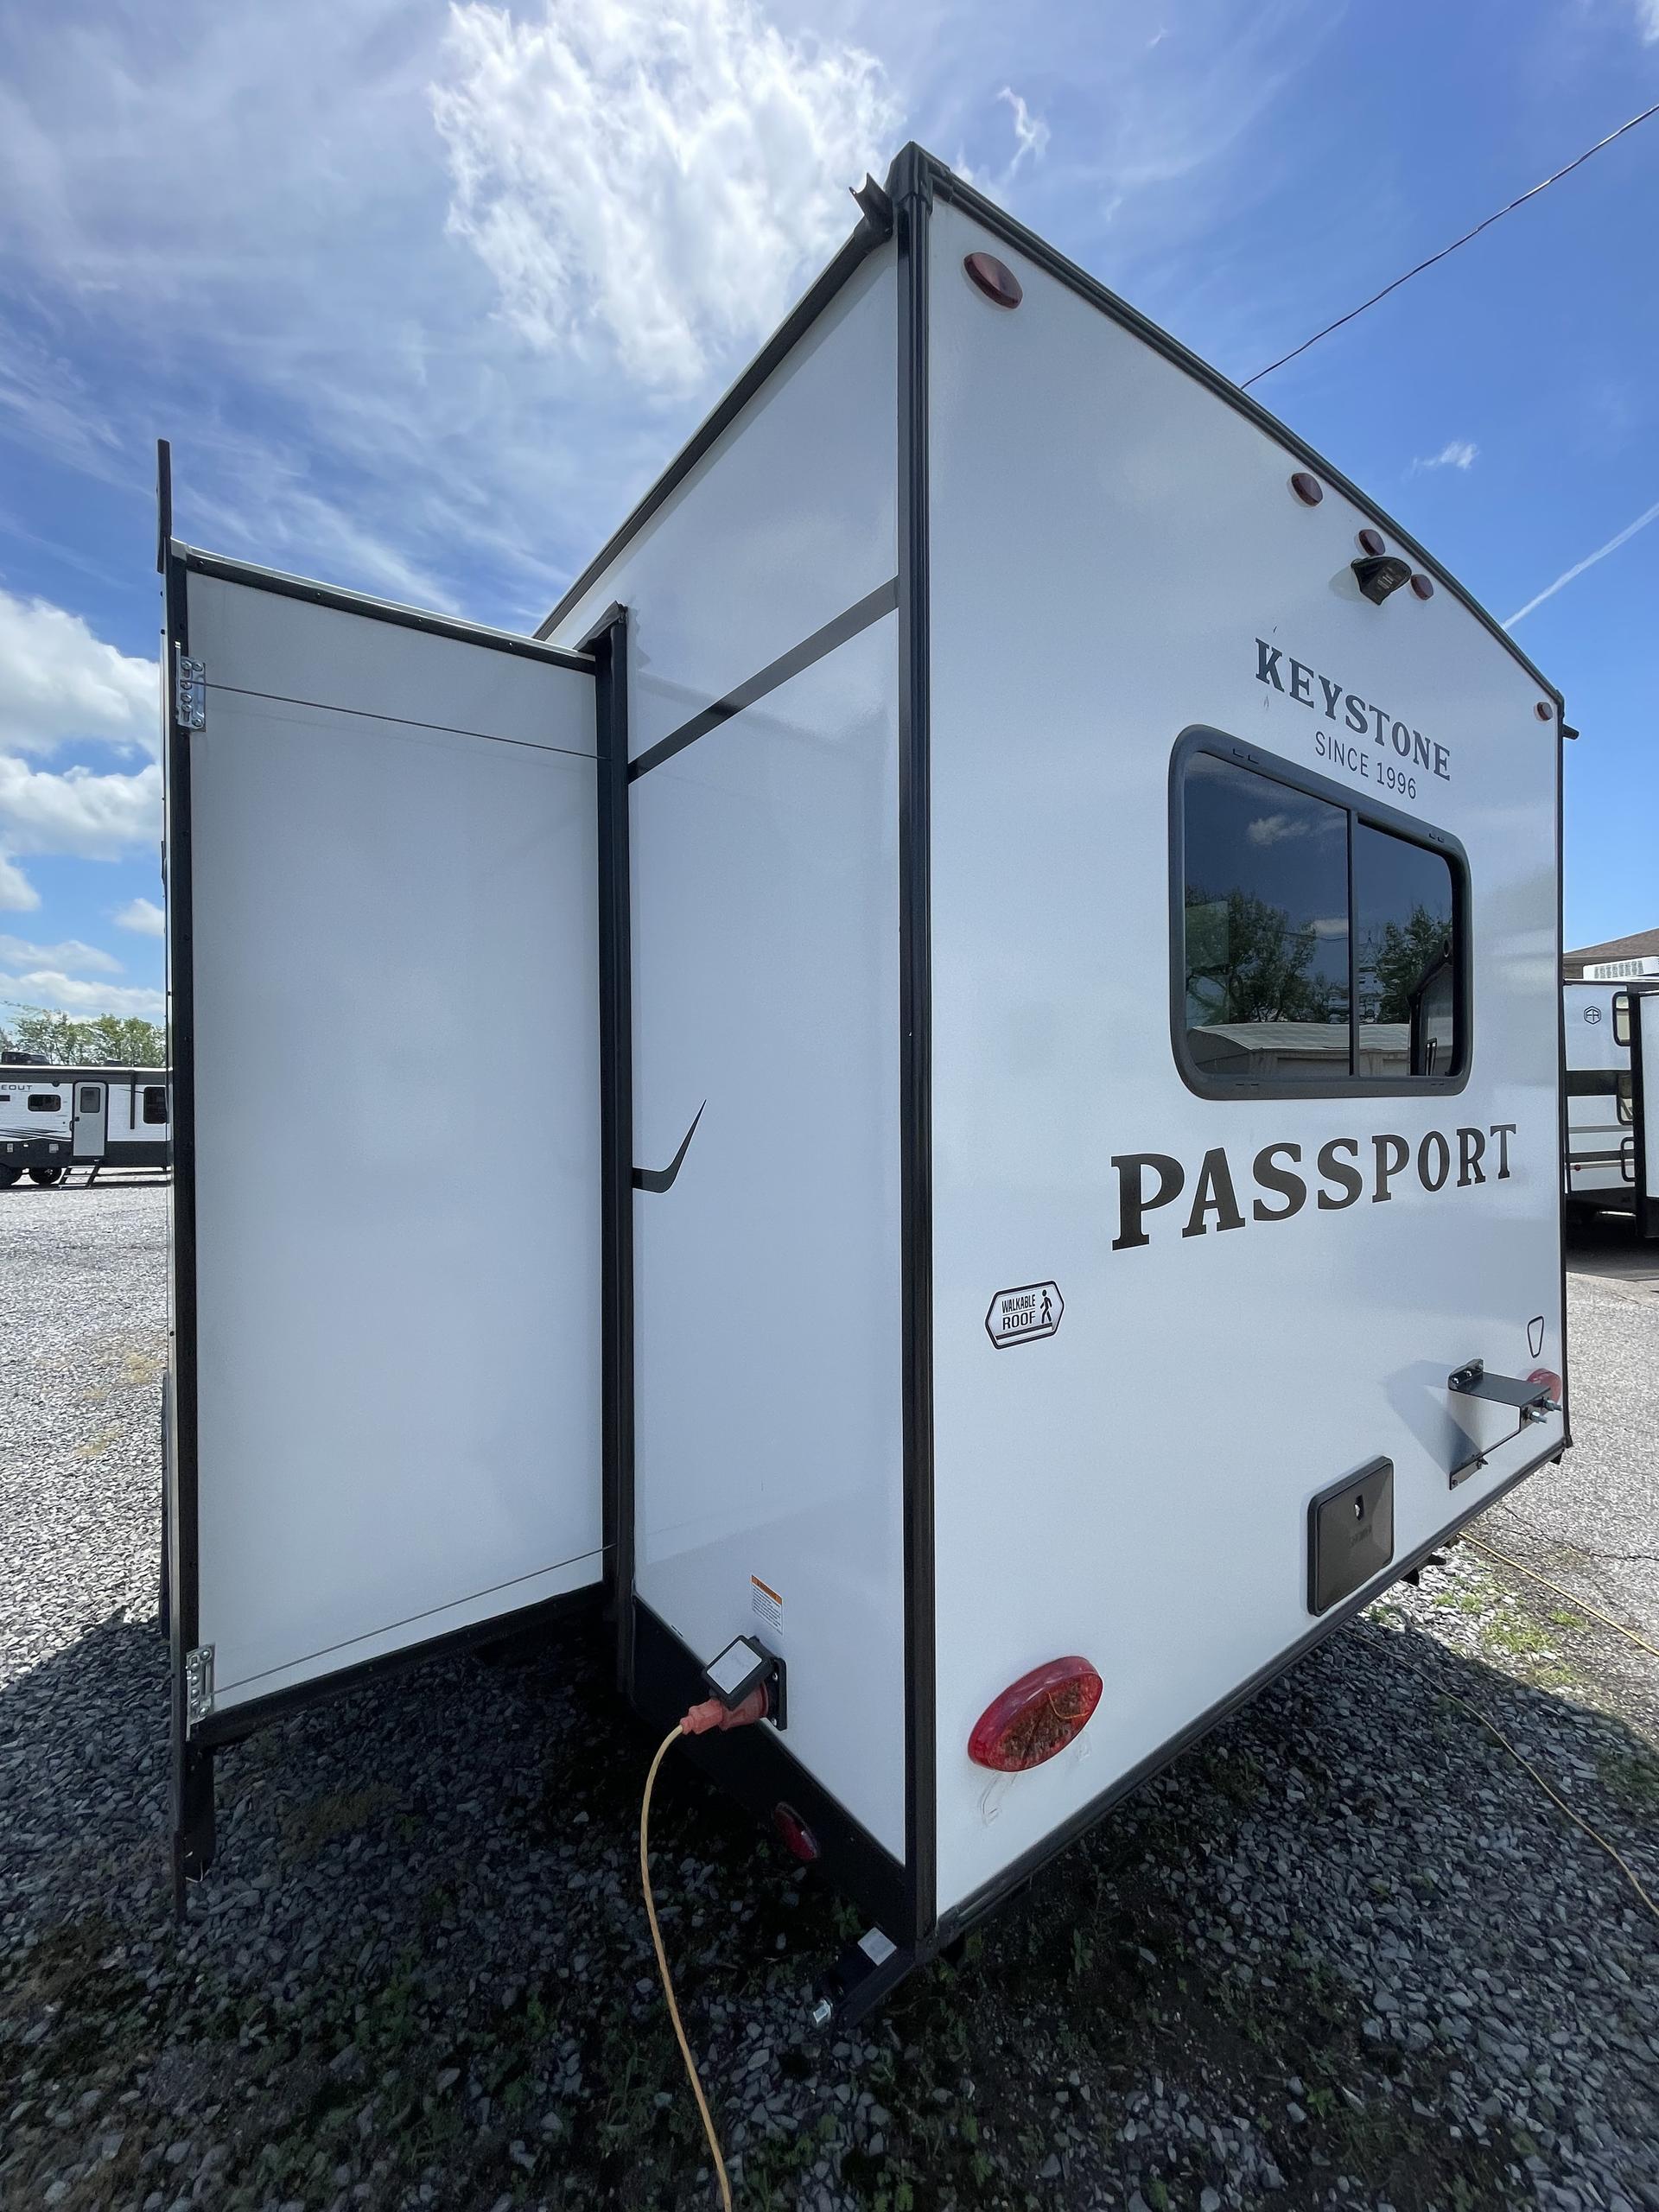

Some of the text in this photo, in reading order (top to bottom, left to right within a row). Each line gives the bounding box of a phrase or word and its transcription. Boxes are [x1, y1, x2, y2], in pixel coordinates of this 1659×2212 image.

[1255, 637, 1451, 781] KEYSTONE
[1315, 731, 1417, 799] SINCE 1996
[1111, 1124, 1516, 1250] PASSPORT
[1002, 1294, 1035, 1313] WALKABLE
[1002, 1311, 1035, 1330] ROOF
